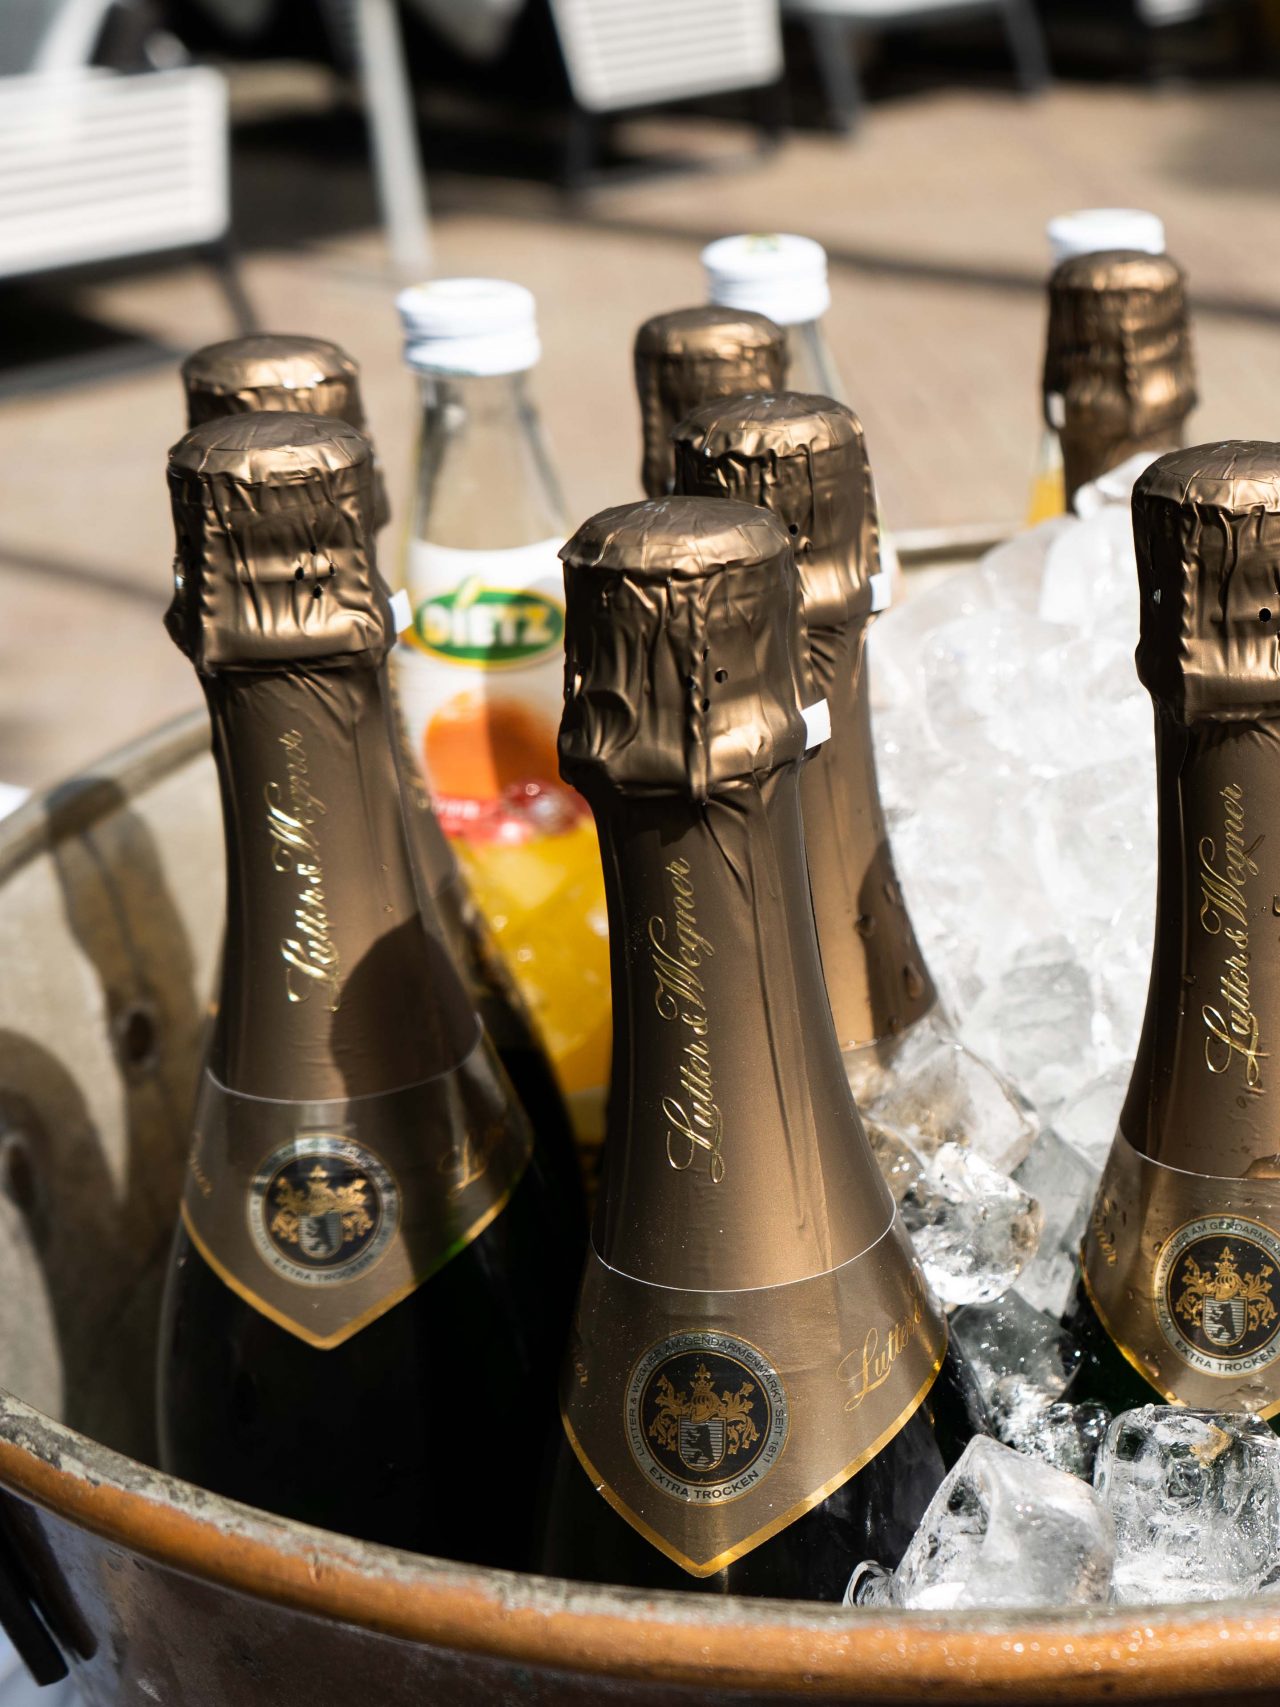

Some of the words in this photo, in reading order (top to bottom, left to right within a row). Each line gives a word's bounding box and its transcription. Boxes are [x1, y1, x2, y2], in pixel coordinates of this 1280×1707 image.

[423, 602, 552, 648] DIETZ
[1199, 783, 1259, 934] Wegner
[649, 857, 716, 1020] Wegner
[1224, 927, 1249, 950] &
[681, 1012, 709, 1036] &
[1202, 953, 1260, 1086] Lutter
[661, 1040, 725, 1184] Lutter
[1160, 1232, 1191, 1271] WEGNER
[1191, 1224, 1208, 1237] AM
[665, 1338, 681, 1353] AM
[1174, 1339, 1212, 1369] EXTRA
[1217, 1346, 1277, 1372] TROCKEN
[632, 1350, 665, 1393] WEGNER
[628, 1408, 645, 1458] LUTTER
[774, 1408, 785, 1437] SEIT
[763, 1440, 780, 1465] 1811
[649, 1465, 690, 1498] EXTRA
[694, 1469, 760, 1500] TROCKEN
